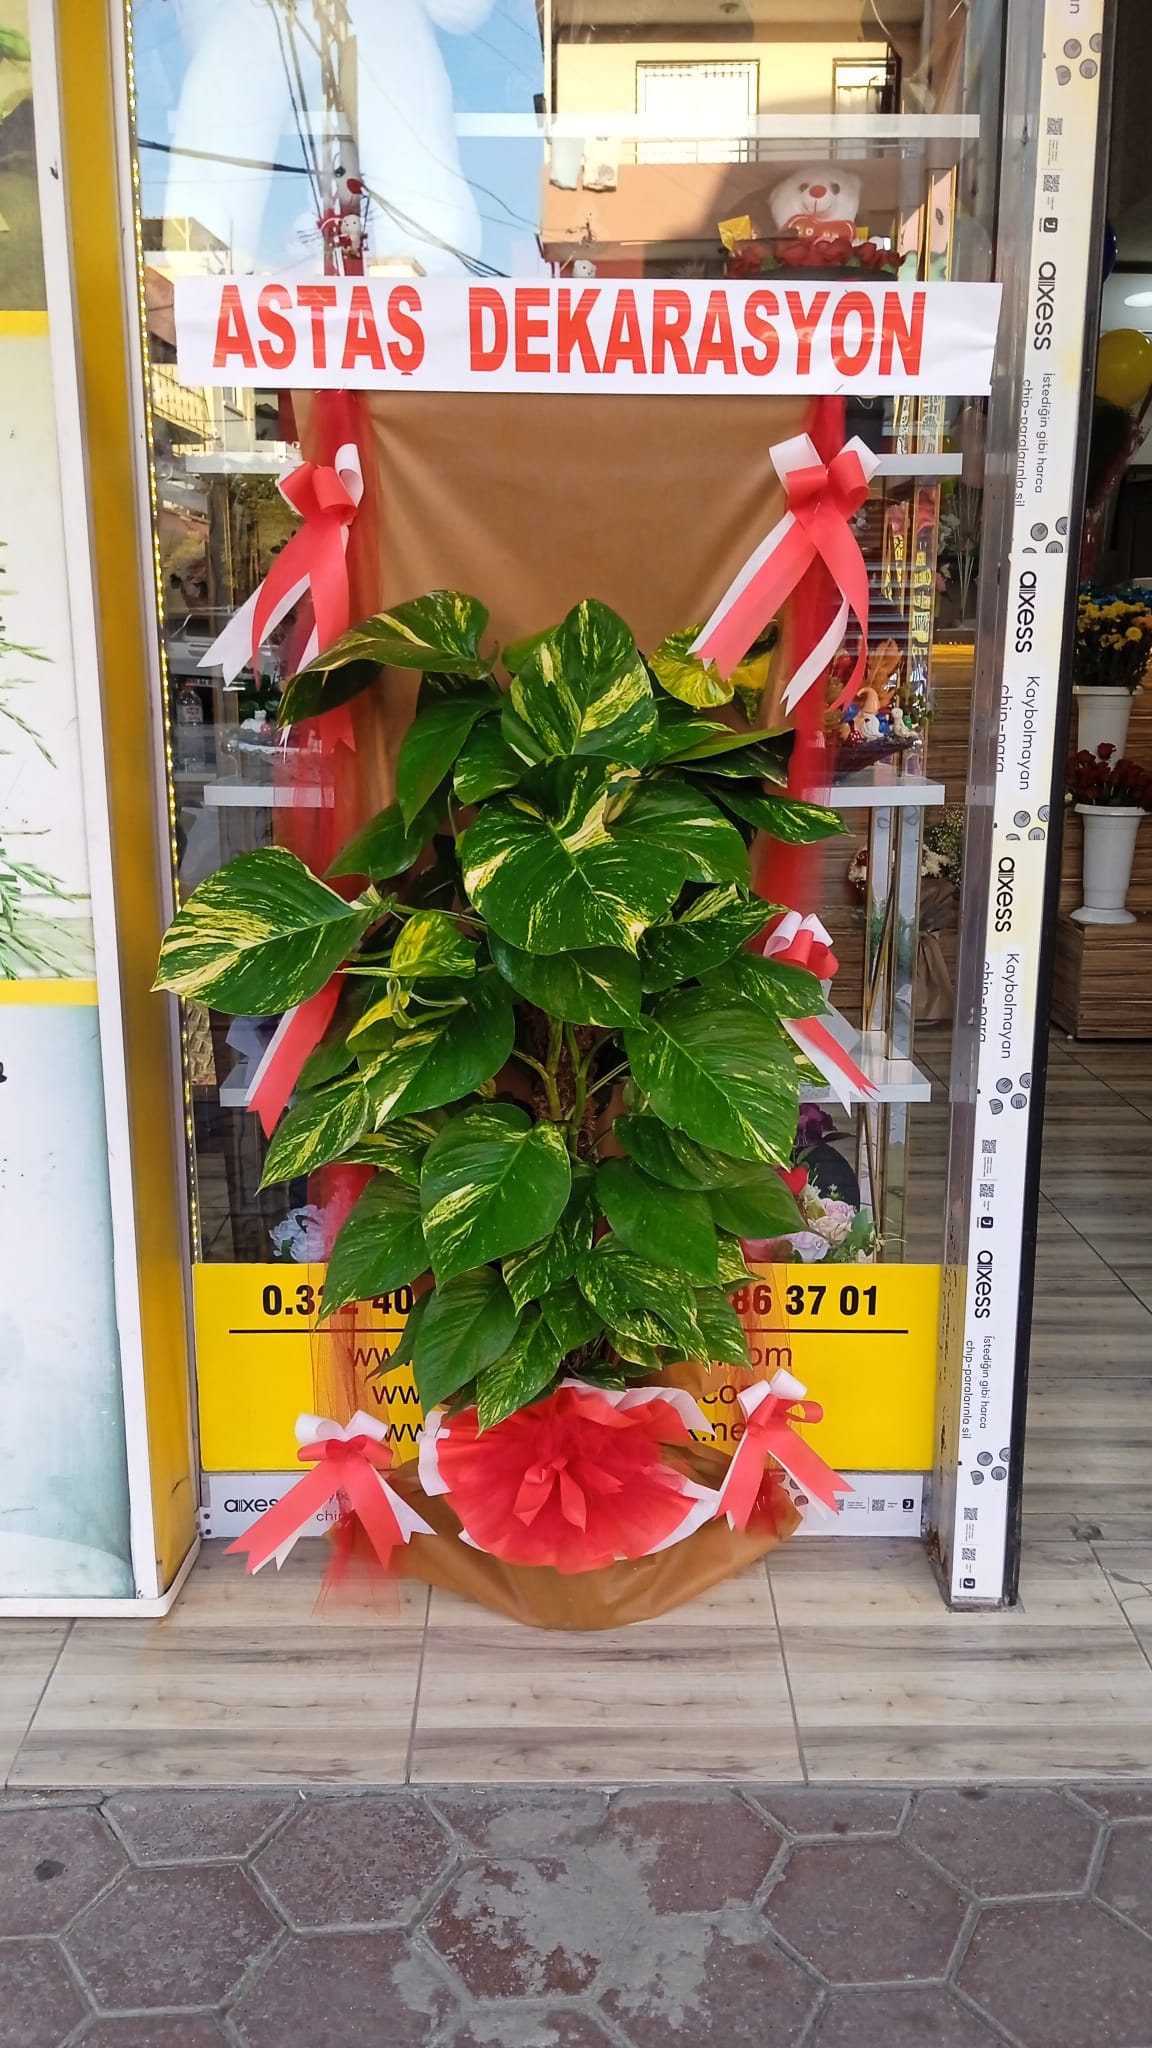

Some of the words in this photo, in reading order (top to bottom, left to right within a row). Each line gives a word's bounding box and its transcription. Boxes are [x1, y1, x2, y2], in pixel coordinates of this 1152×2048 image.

[212, 283, 425, 376] ASTAŞ
[469, 286, 927, 377] DEKARASYON
[1033, 261, 1057, 351] axess
[1037, 372, 1056, 428] İstediğin
[1036, 431, 1050, 455] gibi
[1034, 458, 1048, 494] harca
[1014, 571, 1038, 654] axess
[1017, 675, 1041, 791] Kaybolmayan
[994, 857, 1017, 932] axess
[998, 953, 1020, 1059] Kaybolmayan
[785, 1285, 827, 1315] 37
[839, 1285, 878, 1316] 01
[974, 1250, 994, 1319] axess
[978, 1380, 990, 1399] gibi
[978, 1401, 989, 1429] harca
[961, 1427, 971, 1440] sil
[224, 1499, 279, 1513] axes
